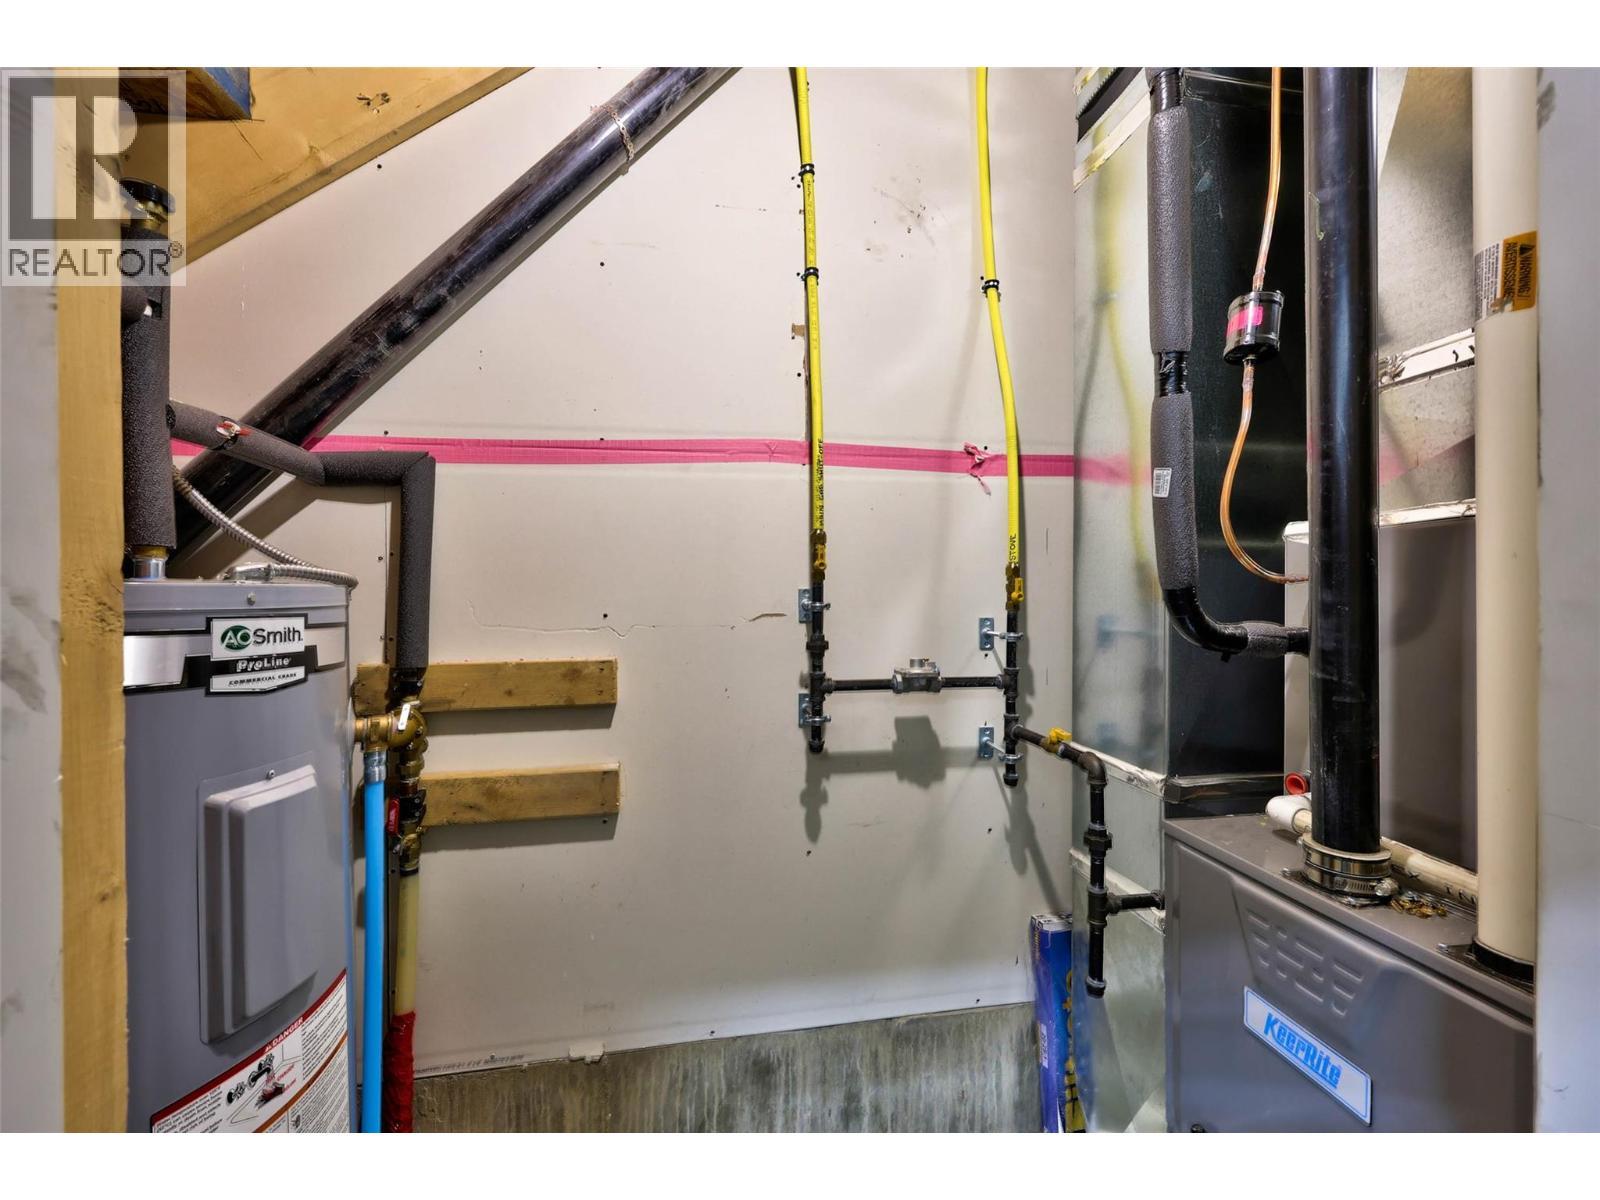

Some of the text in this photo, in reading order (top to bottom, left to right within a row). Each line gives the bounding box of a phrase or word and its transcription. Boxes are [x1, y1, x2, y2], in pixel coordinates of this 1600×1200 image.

[1518, 256, 1532, 292] WARNING
[236, 656, 290, 672] ProLine
[228, 673, 297, 686] COMMERCIAL GRADE
[272, 1016, 303, 1046] DANGER
